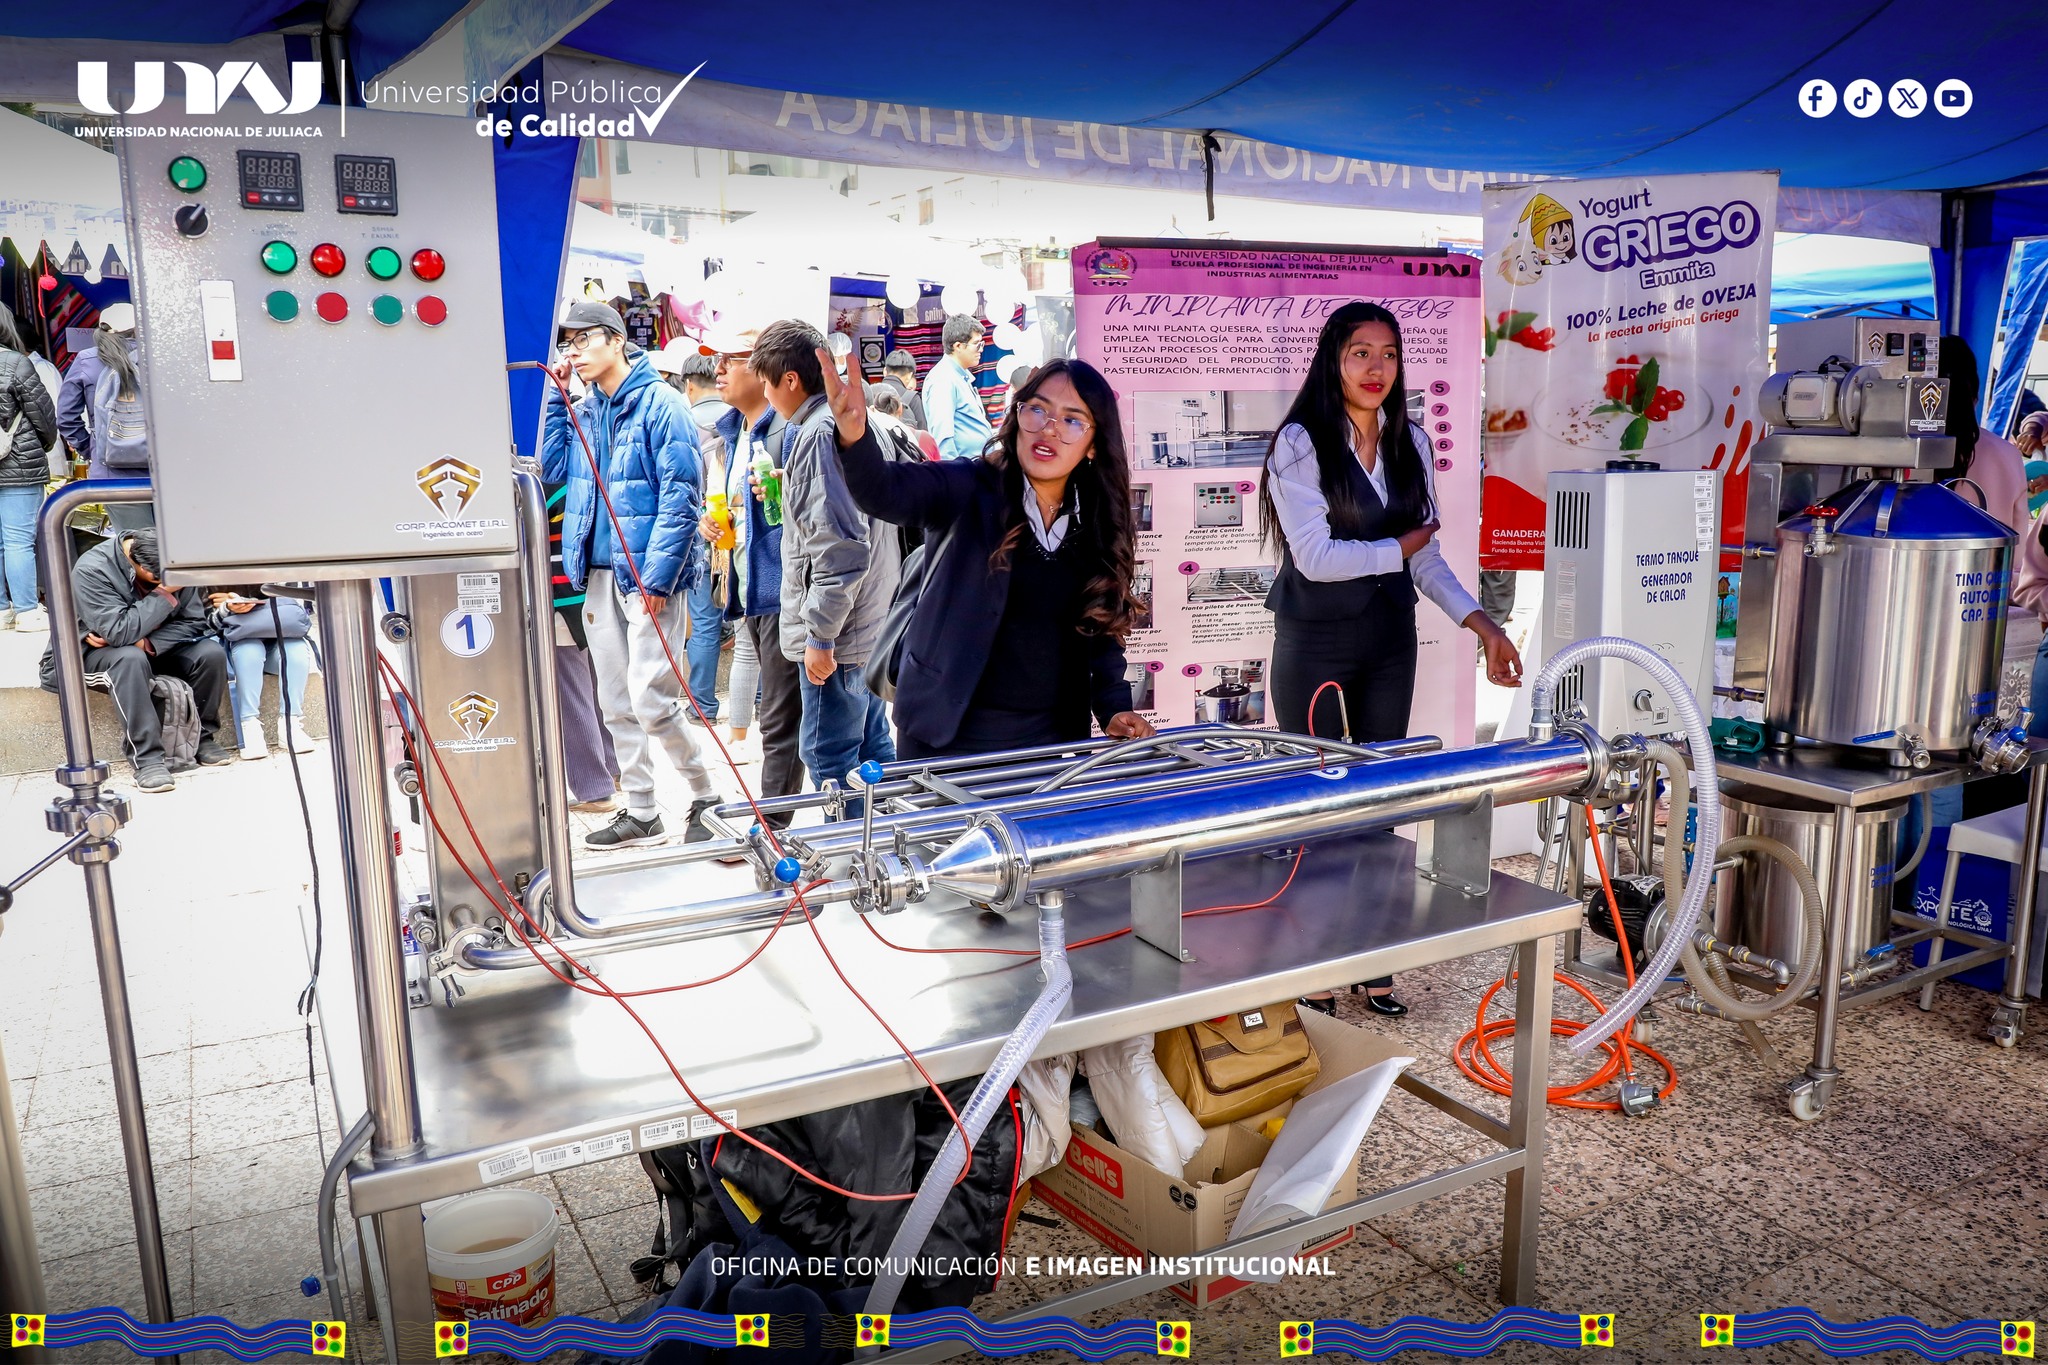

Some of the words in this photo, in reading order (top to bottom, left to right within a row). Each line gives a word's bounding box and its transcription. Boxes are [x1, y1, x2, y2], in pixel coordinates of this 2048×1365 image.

[1578, 188, 1652, 218] Yogurt
[1583, 201, 1760, 272] GRIEGO
[1170, 250, 1257, 261] UNIVERSIDAD
[1261, 252, 1326, 263] NACIONAL
[1329, 254, 1345, 264] DE
[1346, 255, 1394, 265] JULIACA
[1171, 259, 1215, 268] ESCUELA
[1217, 261, 1286, 270] PROFESIONAL
[1206, 270, 1266, 279] INDUSTRIAS
[1269, 272, 1339, 280] ALIMENTARIAS
[1640, 261, 1715, 289] Emmita
[1300, 297, 1350, 319] DE
[1566, 307, 1611, 331] 100%
[1618, 298, 1667, 322] Leche
[1673, 295, 1695, 313] de
[1701, 283, 1757, 307] OVEJA
[1210, 325, 1262, 333] QUESERA,
[1587, 331, 1600, 343] la
[1604, 323, 1643, 341] receta
[1647, 316, 1695, 336] original
[1699, 308, 1739, 326] Griega
[1157, 335, 1229, 343] TECNOLOGÍA
[1222, 346, 1303, 354] CONTROLADOS
[1230, 357, 1293, 365] PRODUCTO,
[1103, 366, 1202, 375] PASTEURIZACIÓN,
[1206, 366, 1290, 374] FERMENTACIÓN
[1435, 384, 1446, 393] 5
[1435, 405, 1445, 414] 7
[1438, 423, 1447, 431] 8
[1439, 441, 1448, 449] 6
[1438, 459, 1448, 468] 9
[1240, 483, 1250, 491] 2
[395, 523, 427, 531] CORP.
[429, 520, 477, 530] FACOMET
[1636, 553, 1665, 567] TERMO
[1666, 550, 1699, 565] TANQUE
[1183, 563, 1194, 573] 4
[1641, 572, 1692, 588] GENERADOR
[1956, 572, 1983, 587] TINA
[1647, 591, 1658, 604] DE
[1659, 588, 1686, 602] CALOR
[1961, 609, 1984, 622] CAP.
[456, 614, 476, 650] 1
[1150, 662, 1159, 670] 5
[1187, 666, 1197, 674] 6
[671, 1121, 685, 1130] 2023
[615, 1134, 631, 1144] 2022
[515, 1153, 530, 1162] 2020
[1069, 1141, 1119, 1189] Bell's
[491, 1272, 522, 1292] CPP
[464, 1286, 549, 1321] Satinado
